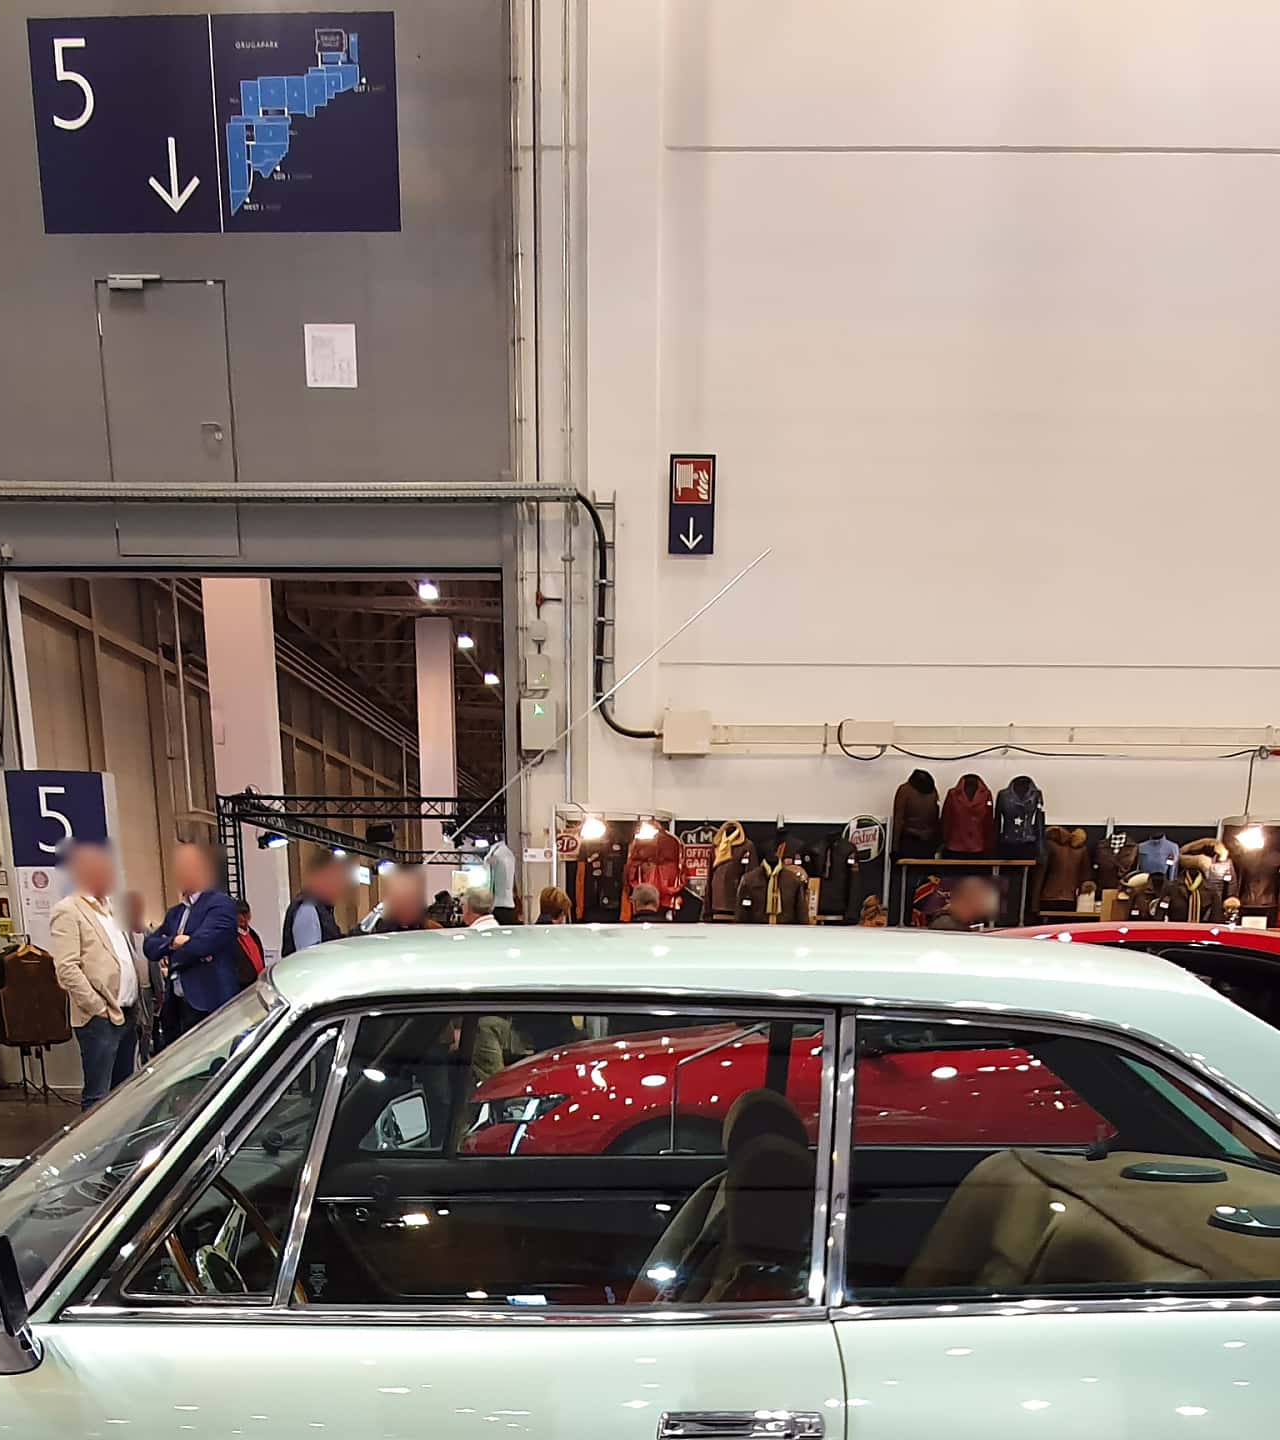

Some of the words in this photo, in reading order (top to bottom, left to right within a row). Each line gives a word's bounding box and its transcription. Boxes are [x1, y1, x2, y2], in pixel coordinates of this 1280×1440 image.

[53, 38, 94, 130] 5
[38, 786, 73, 854] 5
[556, 837, 577, 850] STP
